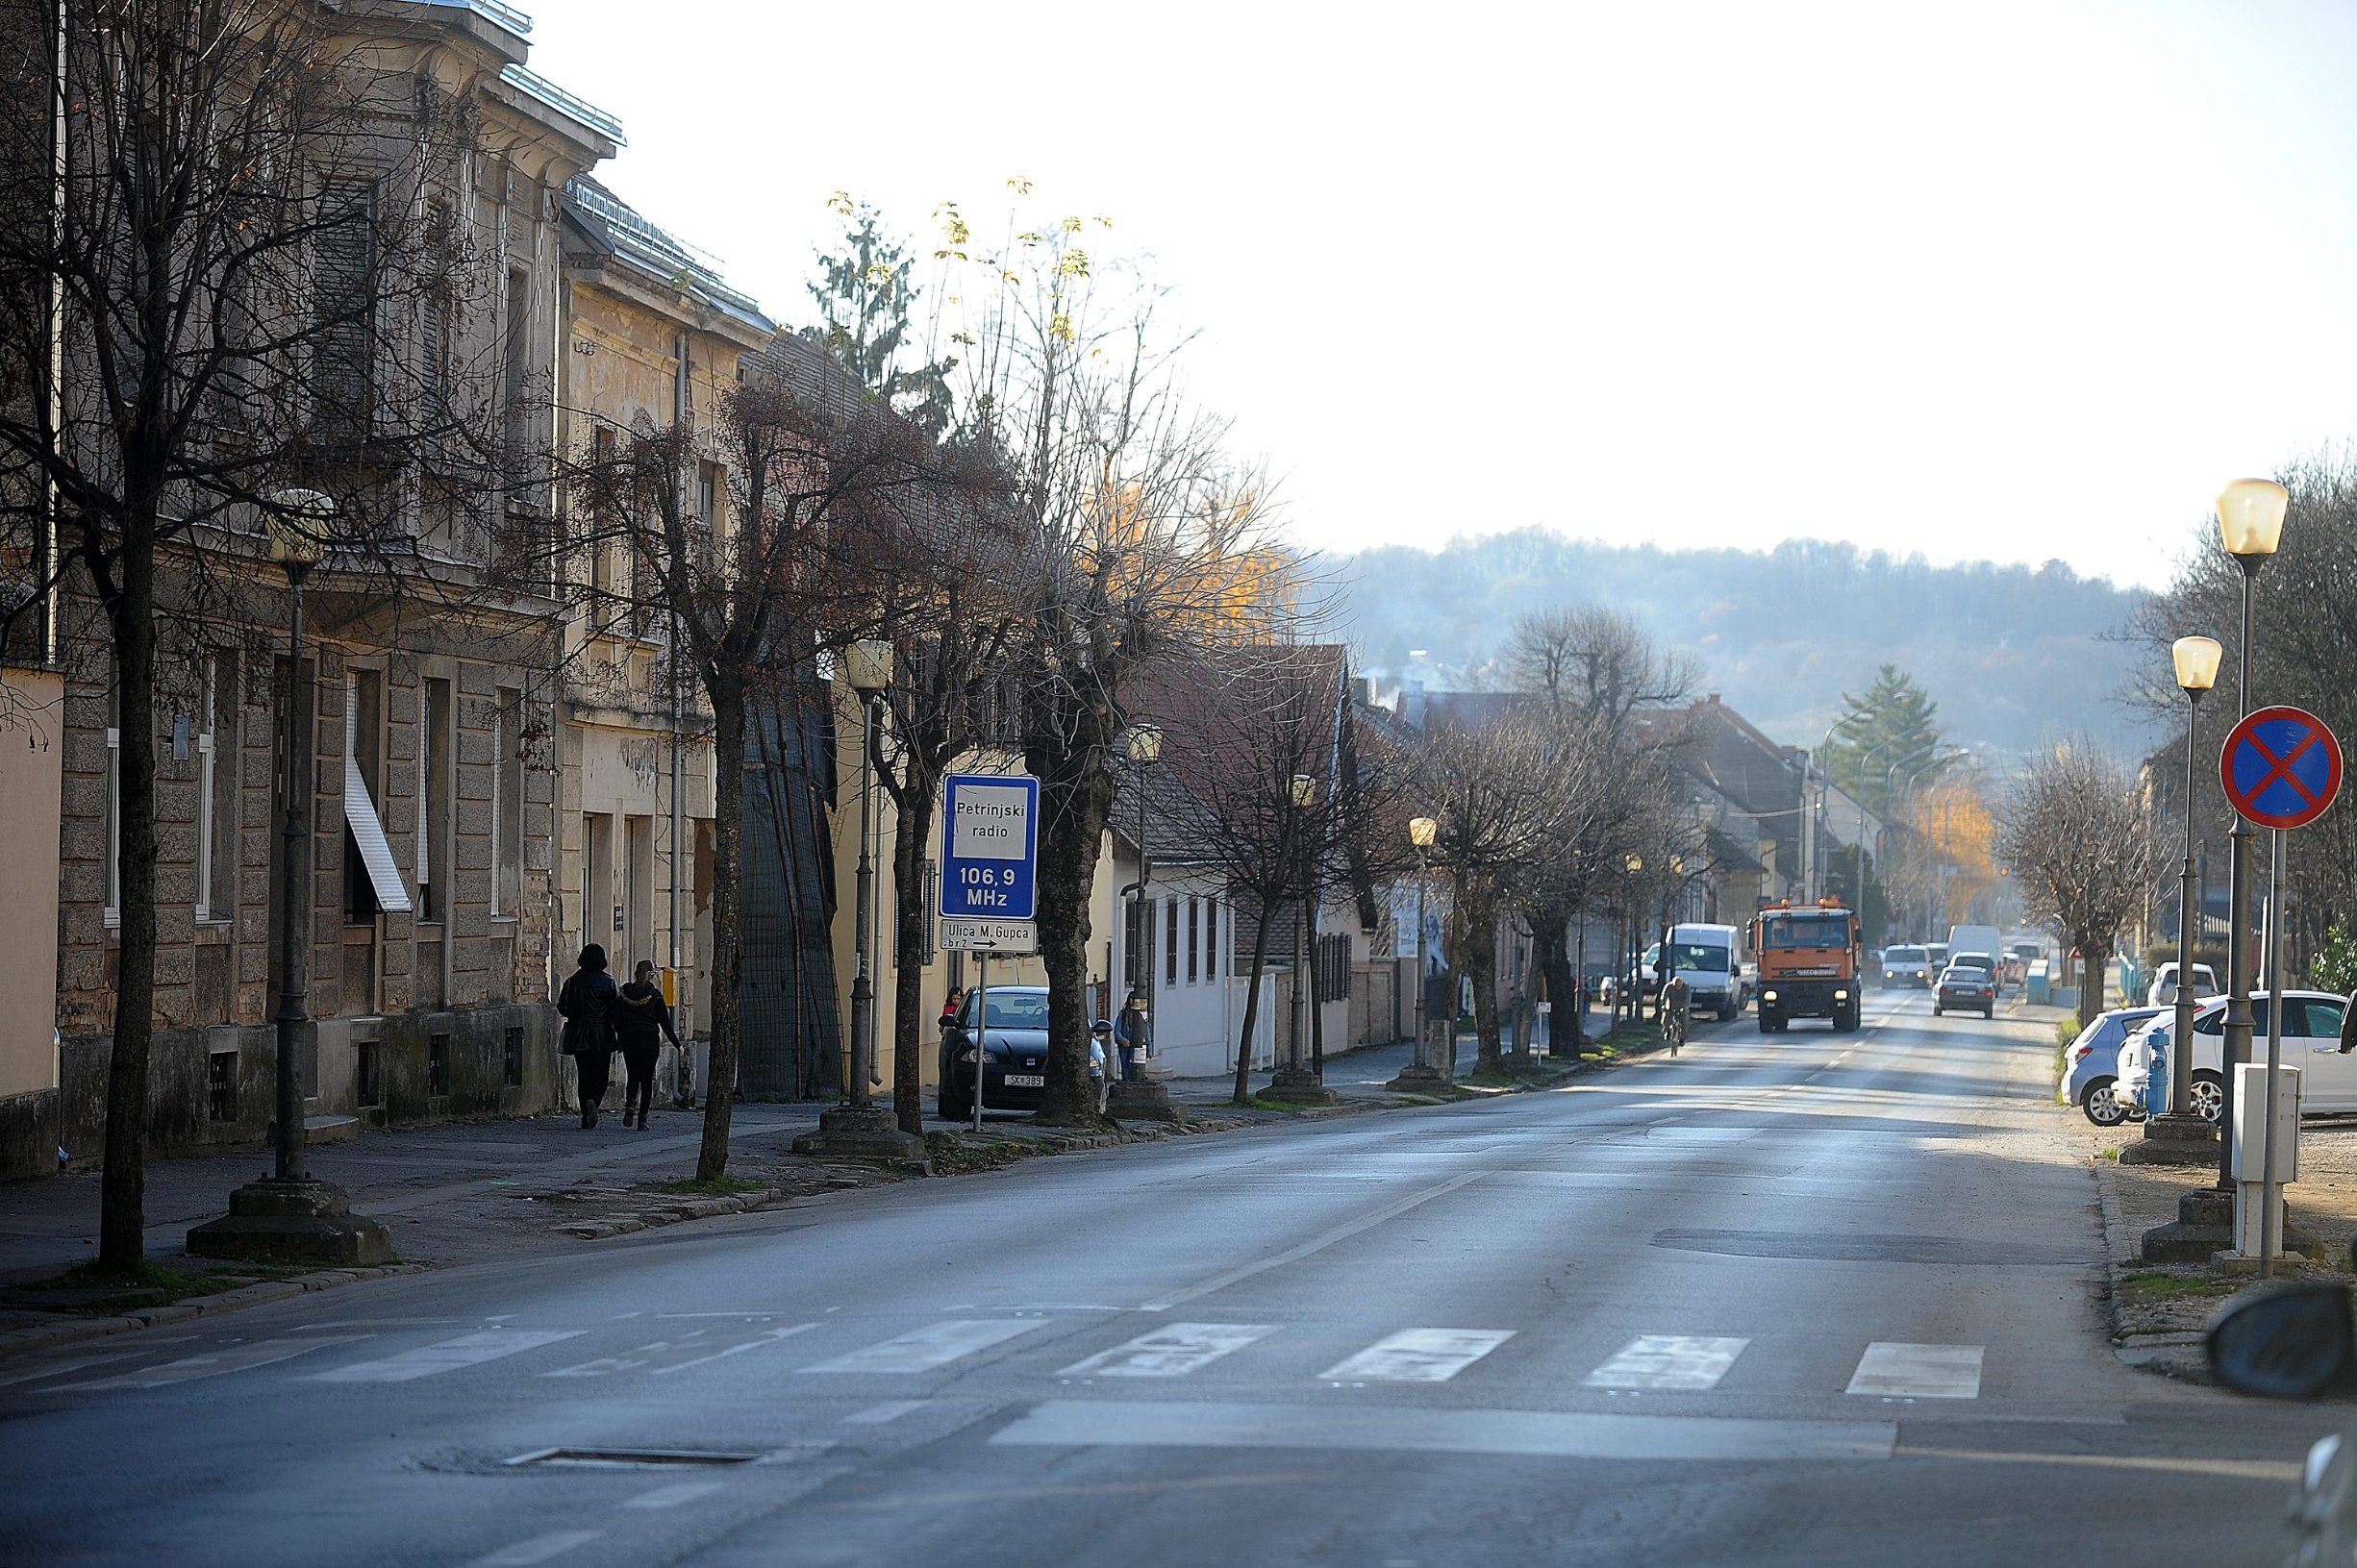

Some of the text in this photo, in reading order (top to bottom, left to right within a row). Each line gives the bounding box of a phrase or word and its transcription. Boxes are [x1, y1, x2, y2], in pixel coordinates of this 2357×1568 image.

[957, 802, 1025, 819] Petrinjski
[972, 825, 1008, 837] radio
[960, 867, 1016, 886] 106,9
[967, 888, 1008, 906] MHz
[948, 924, 975, 936] Ulica
